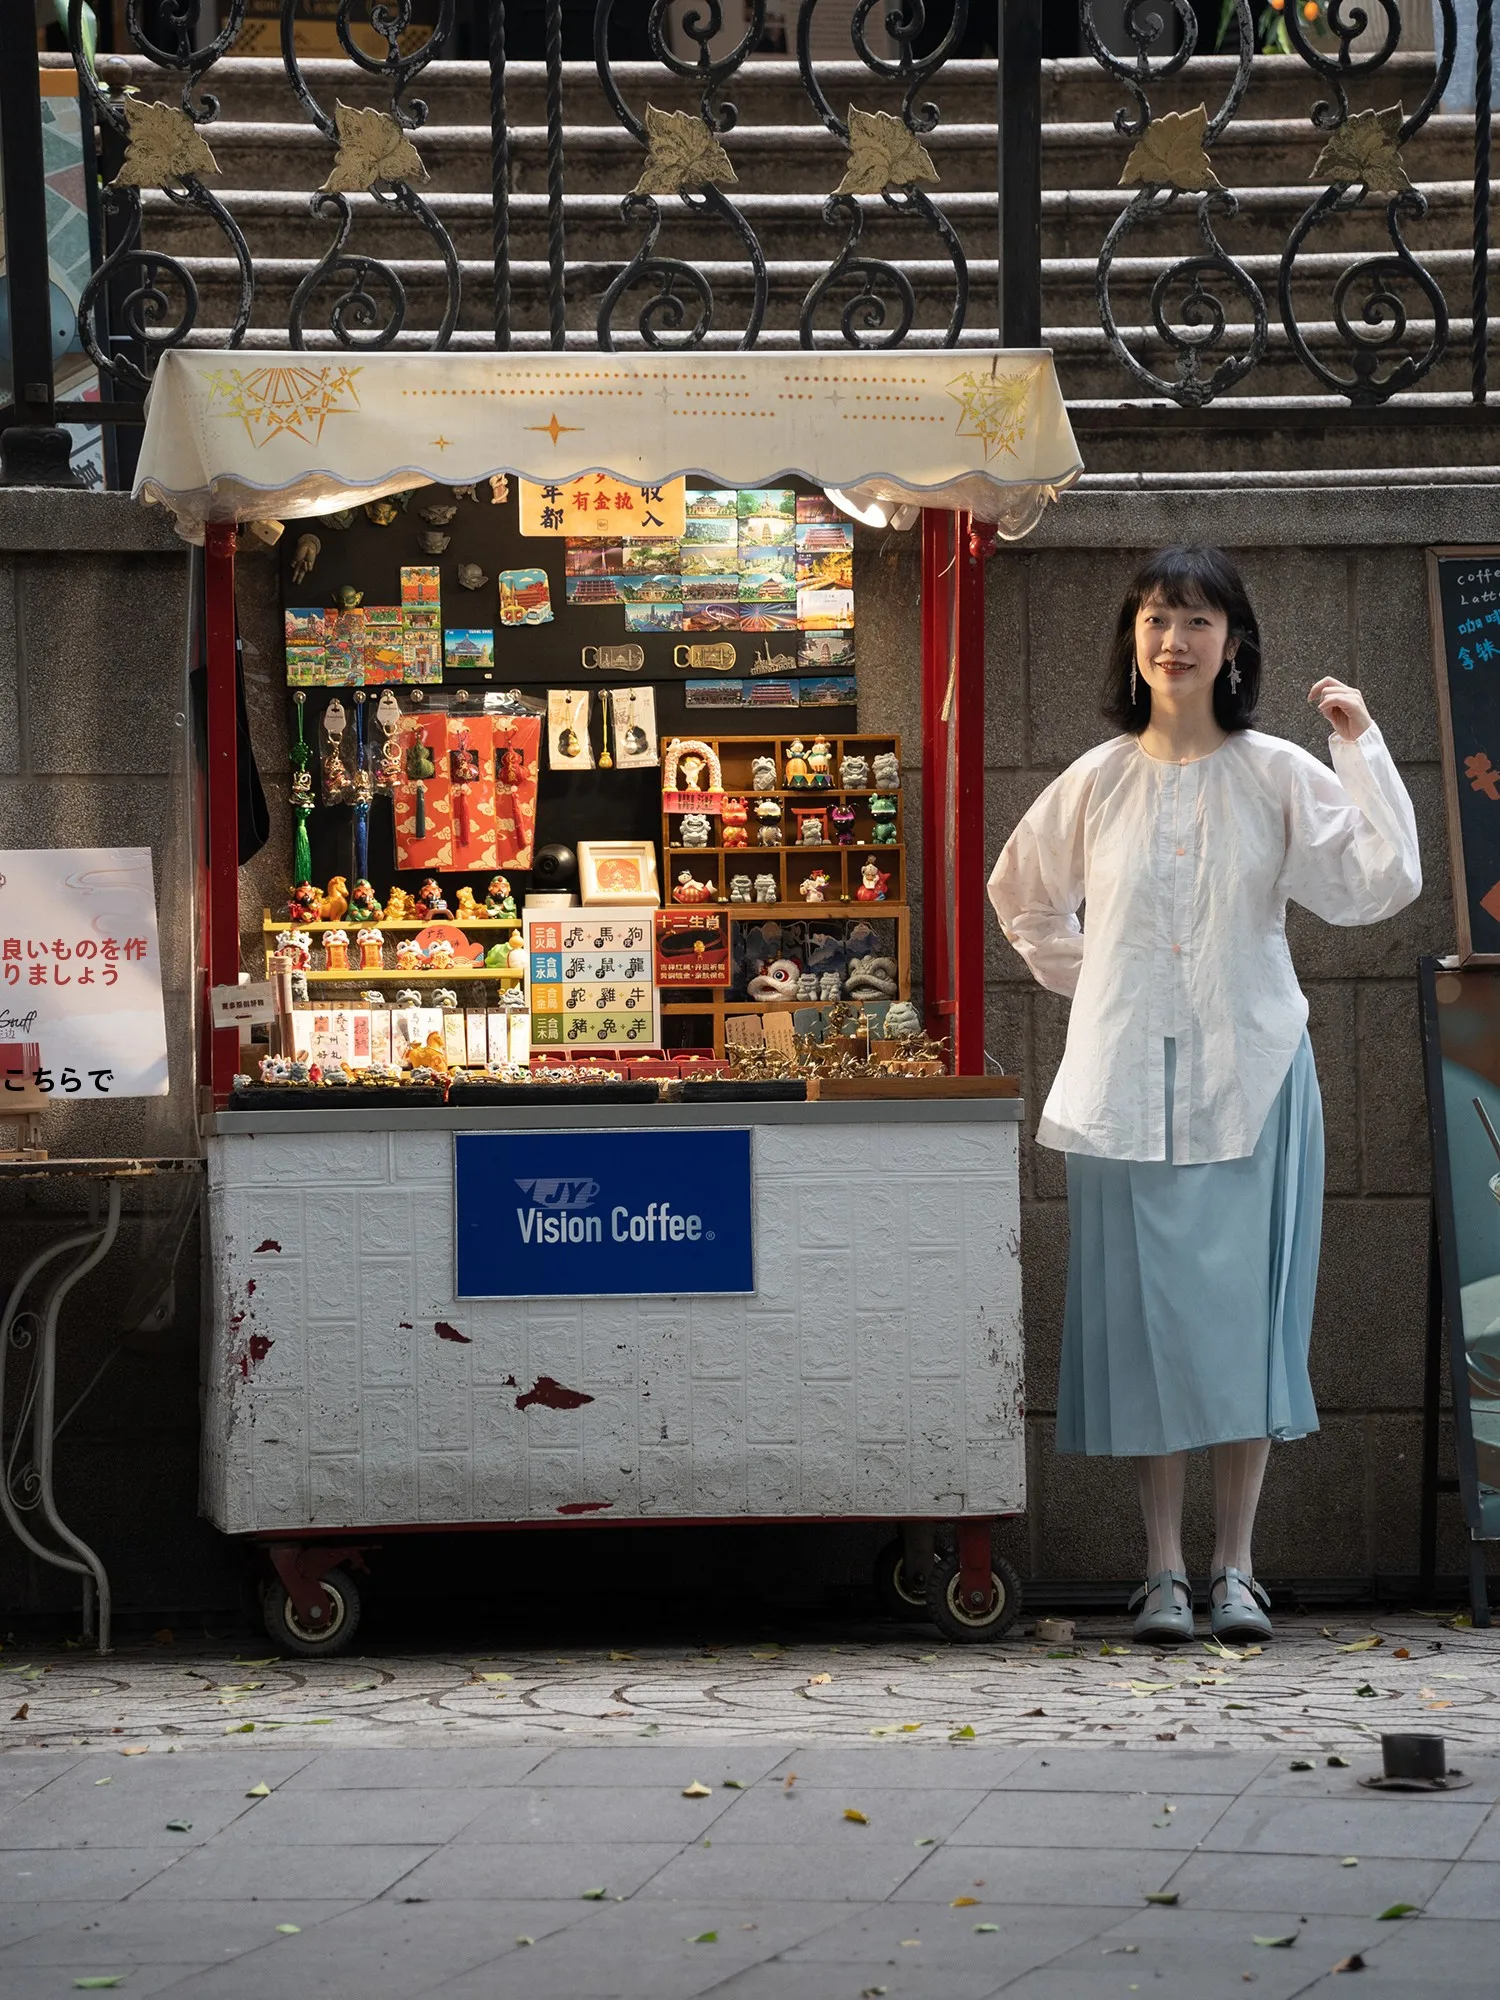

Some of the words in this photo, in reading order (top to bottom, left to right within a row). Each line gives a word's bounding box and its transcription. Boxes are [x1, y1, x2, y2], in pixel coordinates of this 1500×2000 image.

[571, 491, 634, 512] 有金执
[1461, 590, 1500, 605] Latt
[657, 914, 720, 930] 十二生肖
[535, 927, 556, 938] 三合
[569, 927, 584, 942] 虎
[599, 927, 614, 942] 馬
[628, 927, 643, 942] 狗
[1, 937, 148, 962] 良いものを作
[535, 938, 557, 949] 火局
[536, 957, 557, 968] 三合
[570, 957, 585, 972] 猴
[601, 957, 615, 972] 鼠
[629, 957, 644, 972] 龍
[4, 963, 119, 986] りましょう
[536, 968, 557, 979] 水局
[536, 988, 557, 998] 三合
[571, 987, 586, 1002] 蛇
[601, 987, 616, 1002] 雞
[630, 987, 645, 1002] 牛
[536, 998, 557, 1009] 金局
[537, 1018, 558, 1028] 三合
[572, 1018, 587, 1033] 豬
[603, 1018, 617, 1033] 兔
[632, 1018, 646, 1033] 羊
[537, 1029, 559, 1039] 木局
[4, 1067, 114, 1093] こちらで
[516, 1207, 602, 1244] Vision
[611, 1202, 702, 1242] Coffee
